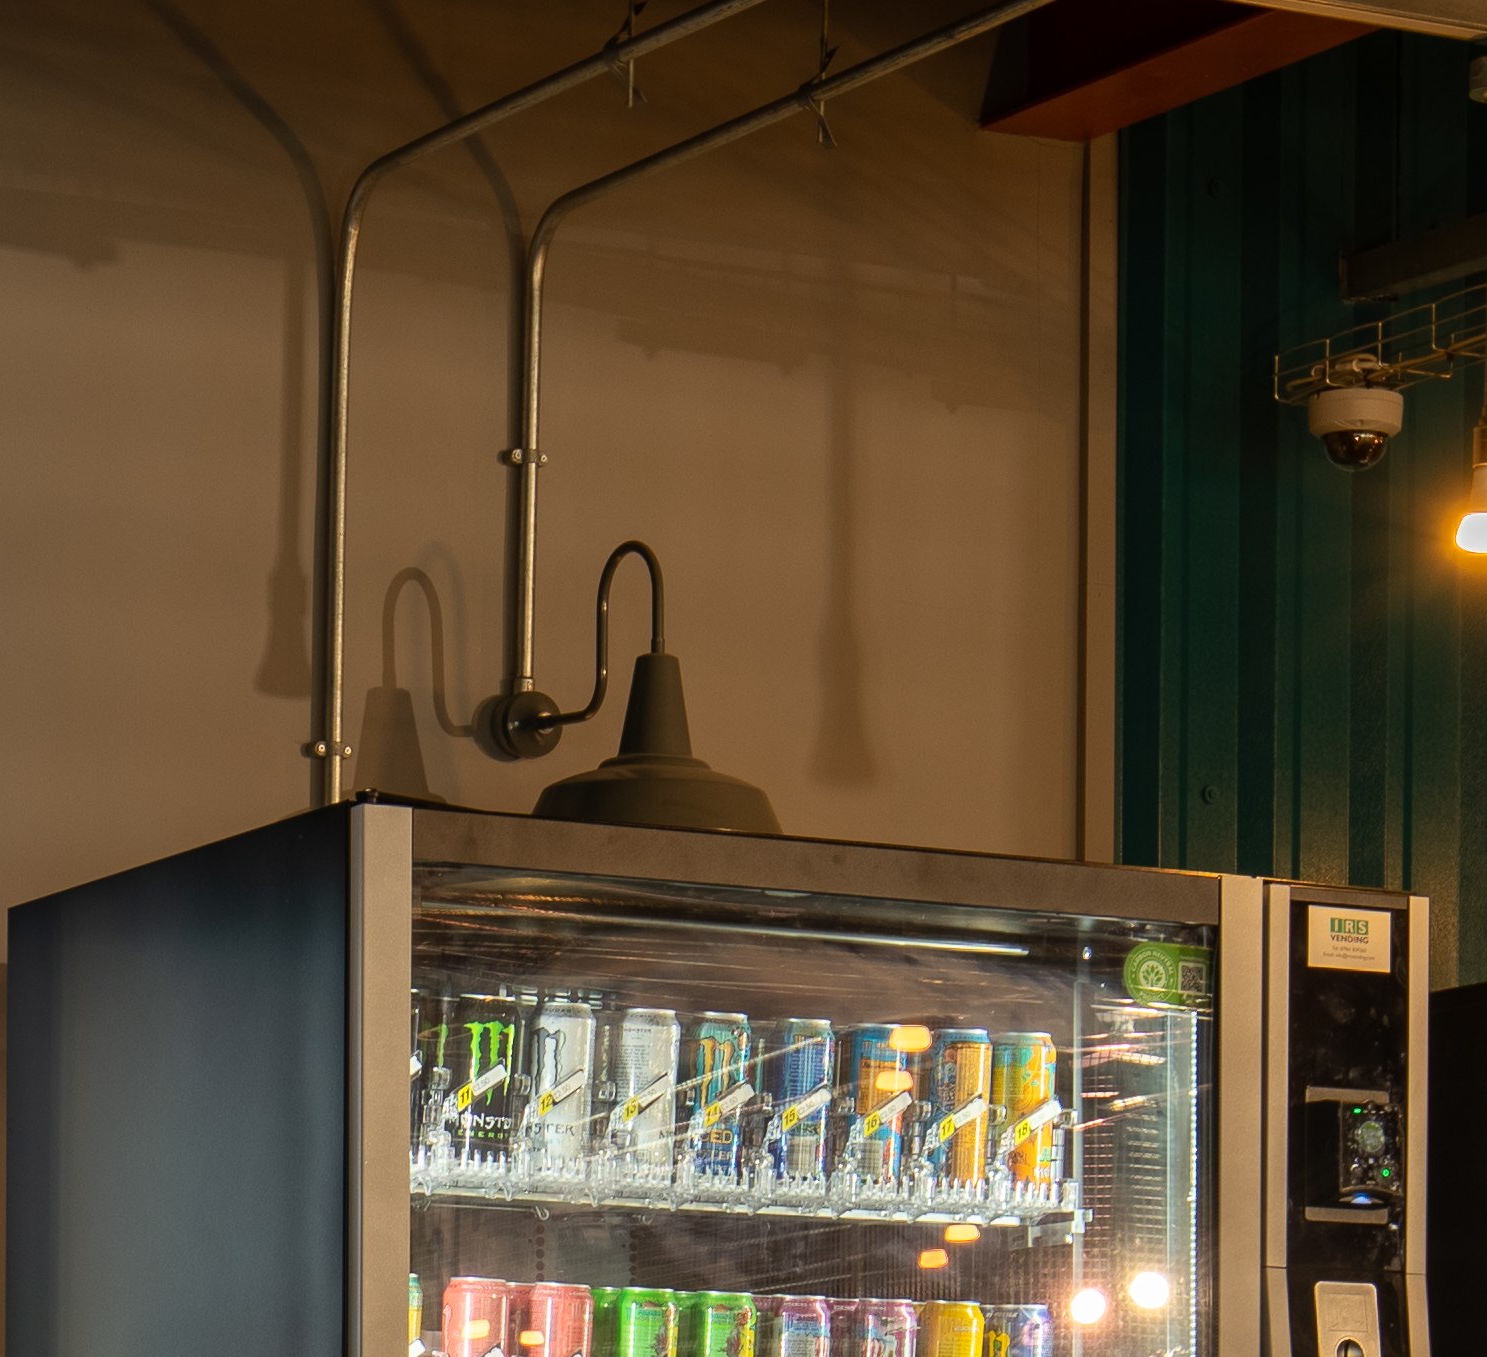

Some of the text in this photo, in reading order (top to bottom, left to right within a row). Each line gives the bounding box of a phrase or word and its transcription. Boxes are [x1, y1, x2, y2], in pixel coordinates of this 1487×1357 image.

[1332, 918, 1368, 935] IRS
[1330, 934, 1369, 944] VENDING
[459, 1088, 472, 1106] 11
[539, 1094, 553, 1111] 12
[448, 1113, 512, 1129] MONST
[705, 1107, 719, 1124] 14
[783, 1109, 797, 1126] 15
[865, 1115, 878, 1132] 16
[526, 1123, 576, 1137] NSTER
[941, 1120, 953, 1137] 17
[1016, 1123, 1028, 1140] 18
